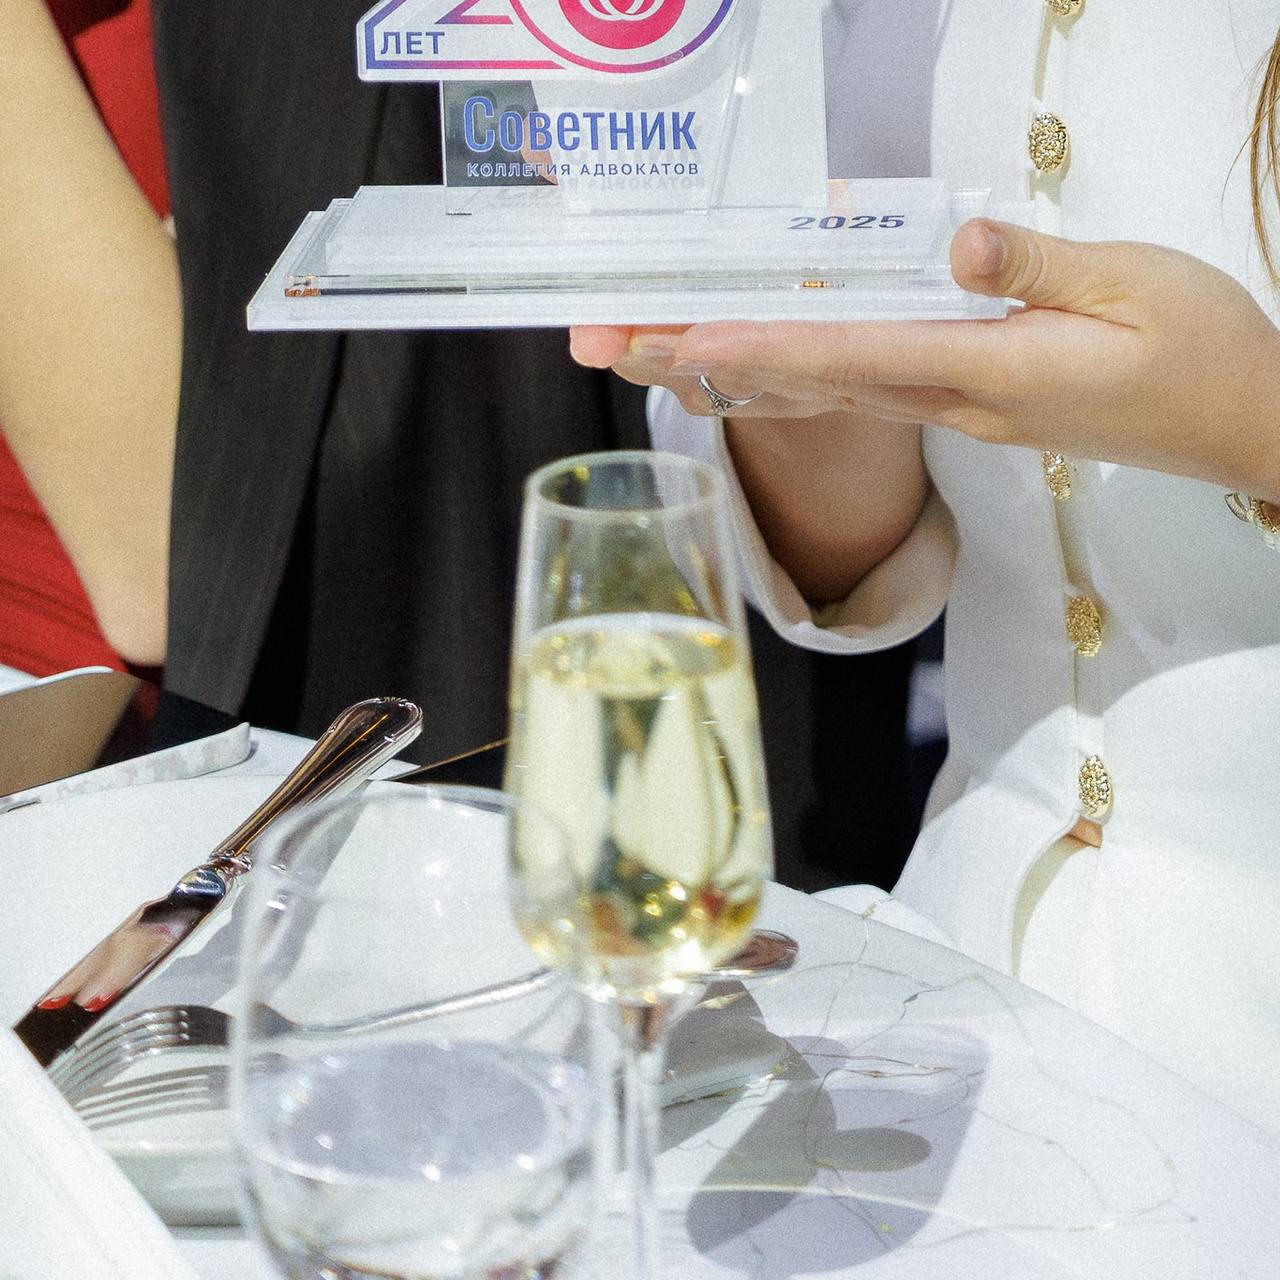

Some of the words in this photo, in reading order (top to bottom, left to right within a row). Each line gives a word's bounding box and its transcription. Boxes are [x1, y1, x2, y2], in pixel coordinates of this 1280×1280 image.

[379, 31, 446, 56] ЛЕТ
[463, 95, 698, 153] Советник
[466, 162, 572, 178] КОЛЛЕГИЯ
[579, 162, 699, 178] АДВОКАТОВ
[786, 214, 906, 230] 2025
